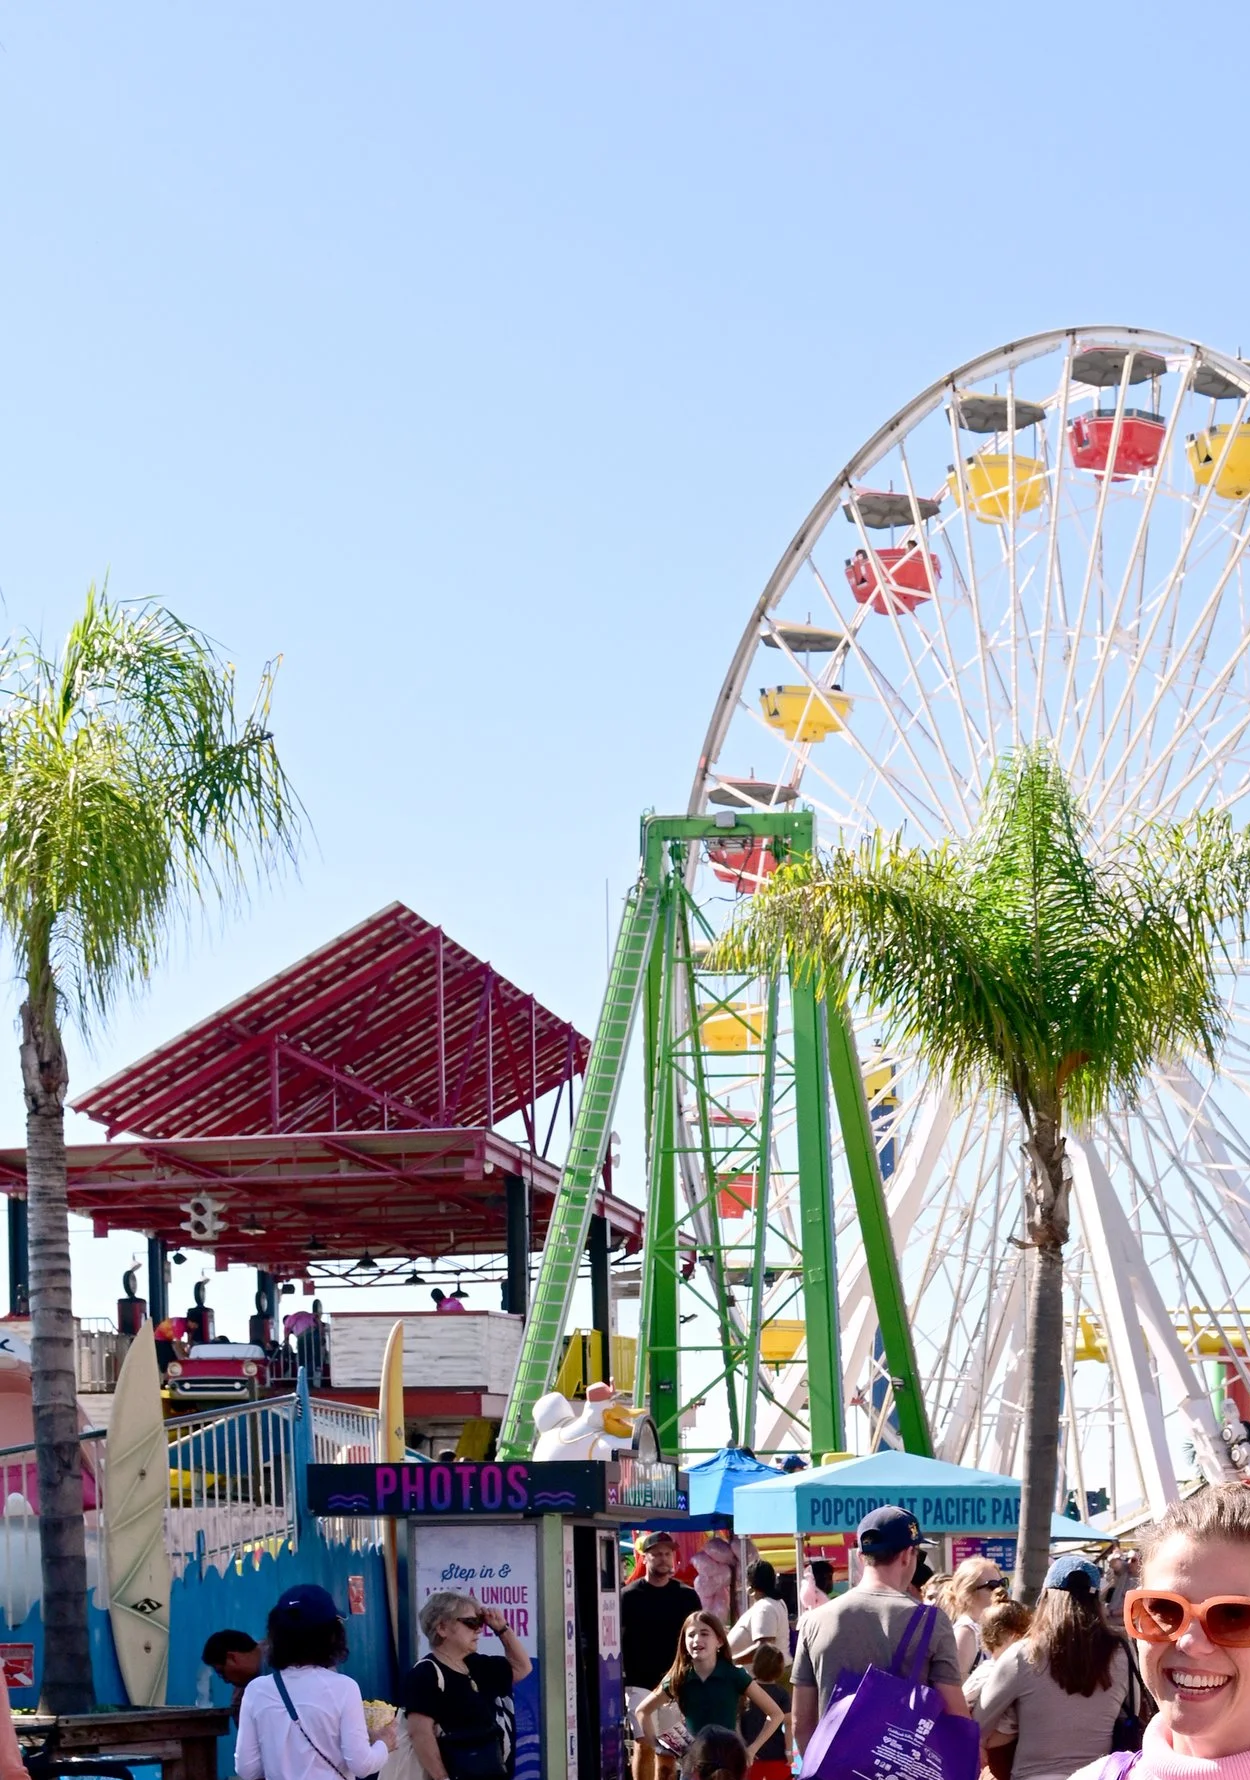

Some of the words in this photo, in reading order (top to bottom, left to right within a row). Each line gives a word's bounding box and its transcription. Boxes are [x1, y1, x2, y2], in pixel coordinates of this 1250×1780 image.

[375, 1465, 528, 1510] PHOTOS
[923, 1498, 986, 1525] PACIFIC
[992, 1498, 1021, 1525] PAR
[441, 1563, 476, 1582] Step
[479, 1565, 495, 1578] in
[499, 1563, 511, 1578] &
[481, 1586, 528, 1605] UNIQUE
